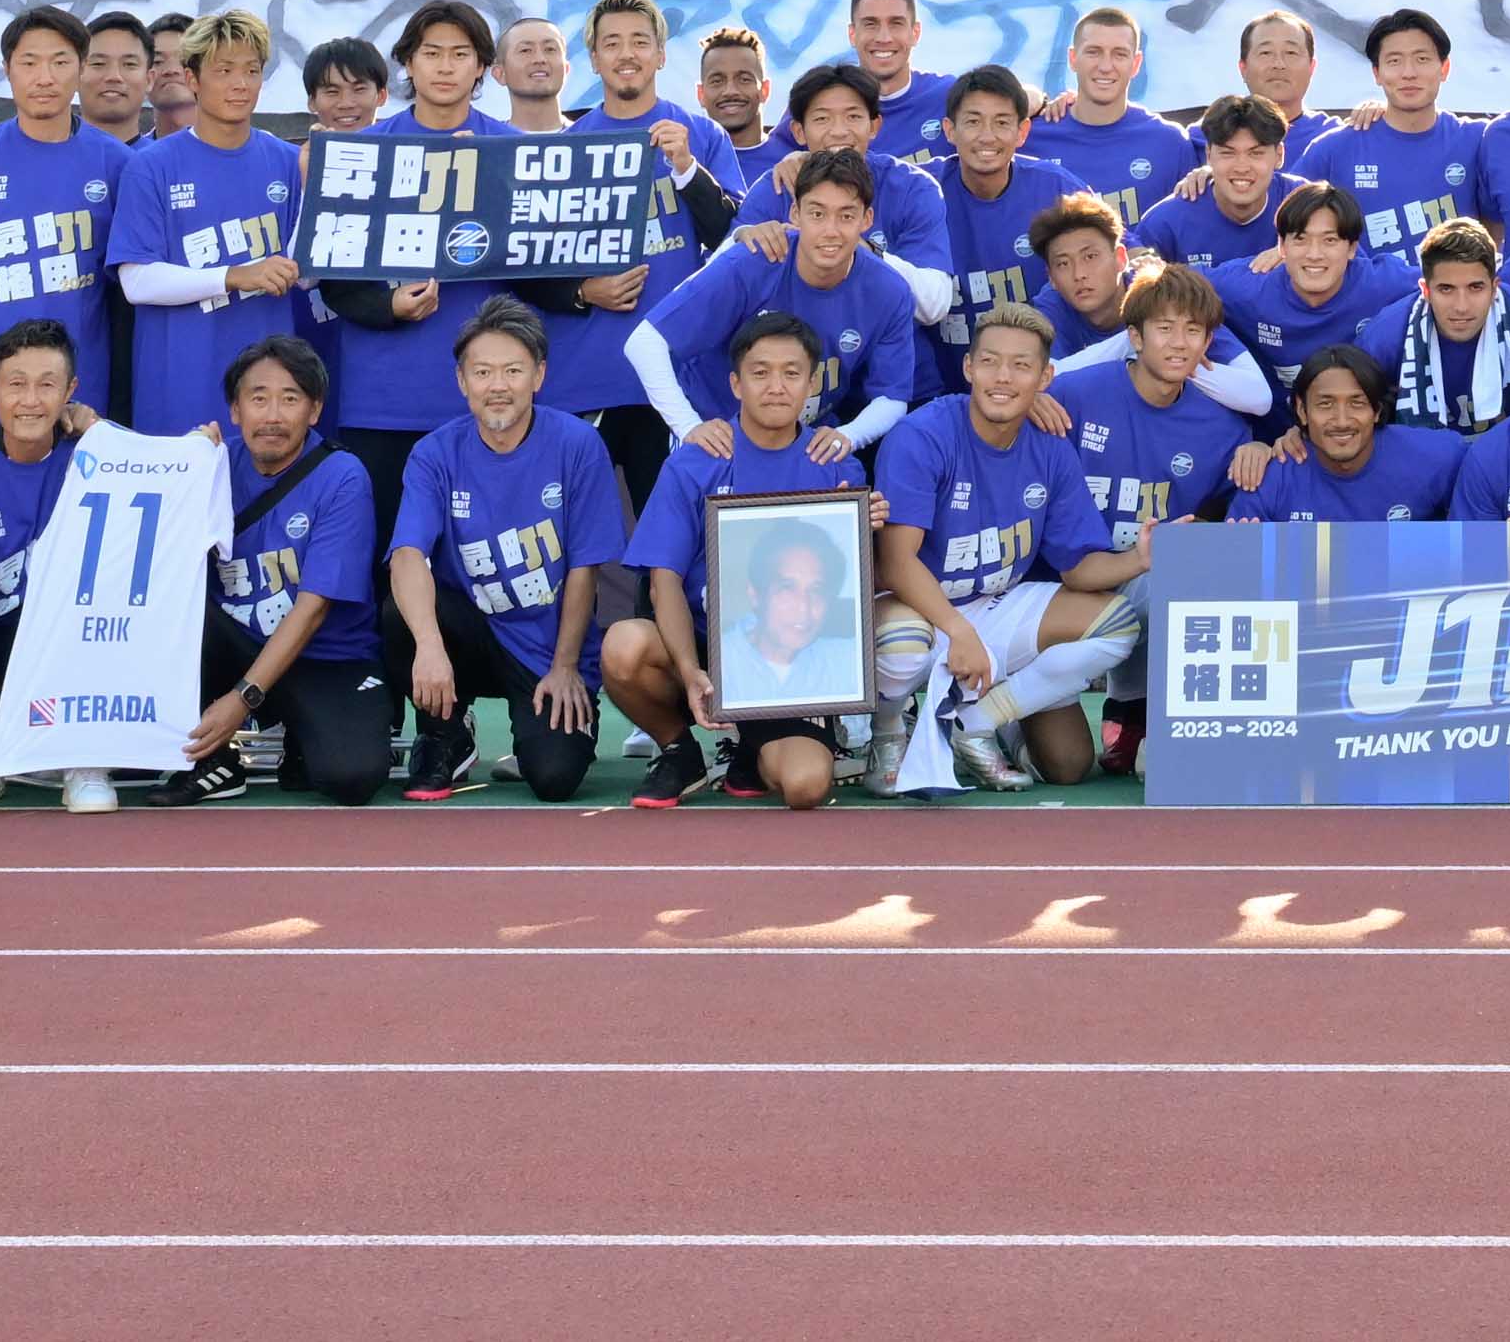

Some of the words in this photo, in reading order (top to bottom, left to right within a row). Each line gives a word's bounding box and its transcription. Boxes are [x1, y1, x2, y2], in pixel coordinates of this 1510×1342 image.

[515, 143, 573, 181] GO
[585, 142, 645, 178] TO
[419, 151, 478, 213] J1
[510, 188, 531, 225] THE
[530, 185, 638, 226] NEXT
[505, 229, 632, 268] STAGE!
[98, 457, 190, 479] odakyu
[75, 491, 164, 607] 11
[81, 615, 130, 644] ERIK
[60, 696, 157, 725] TERADA
[1170, 720, 1223, 739] 2023
[1246, 718, 1299, 738] 2024
[1335, 729, 1433, 761] THANK
[1440, 721, 1500, 752] YOU
